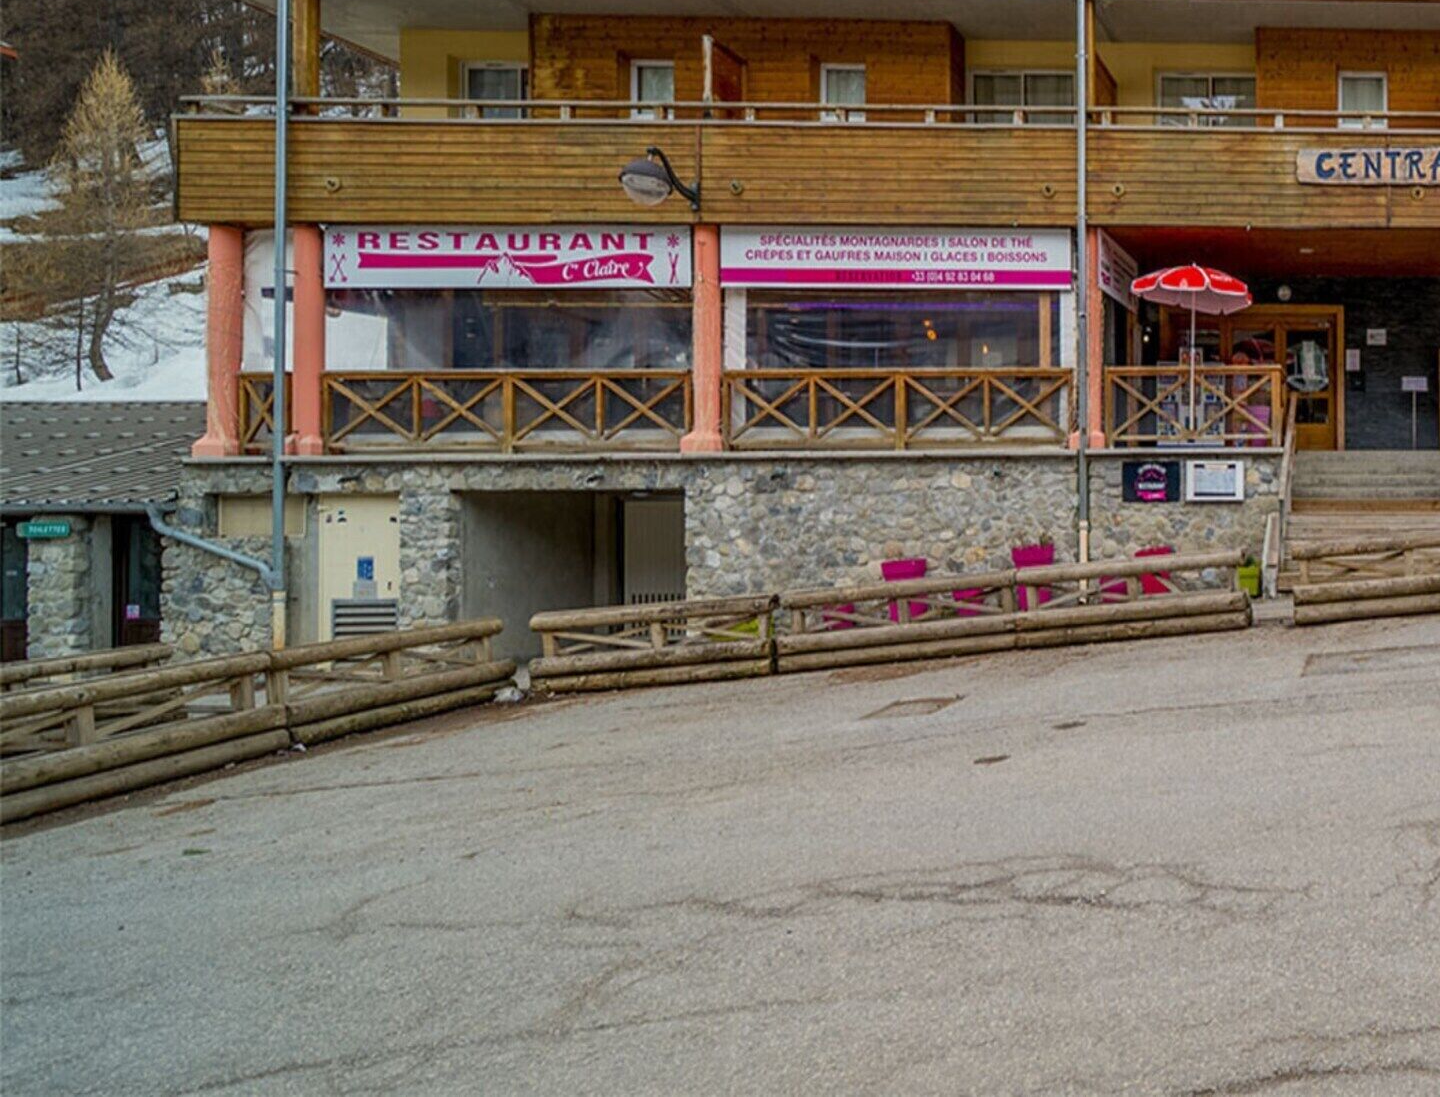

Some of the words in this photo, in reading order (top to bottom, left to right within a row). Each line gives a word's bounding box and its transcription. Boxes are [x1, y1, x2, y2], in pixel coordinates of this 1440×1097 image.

[357, 232, 655, 250] RESTAURANT
[760, 233, 836, 246] SPÉCIALITÉS
[839, 235, 938, 248] MONTAGNARDES
[950, 237, 988, 248] SALON
[991, 238, 1007, 248] DE
[1011, 236, 1034, 248] THÉ
[797, 250, 811, 261] ET
[815, 250, 871, 261] GAUFRES
[874, 251, 921, 262] MAISON
[931, 251, 978, 262] GLACES
[987, 252, 1048, 263] BOISSONS
[583, 259, 631, 278] Claire
